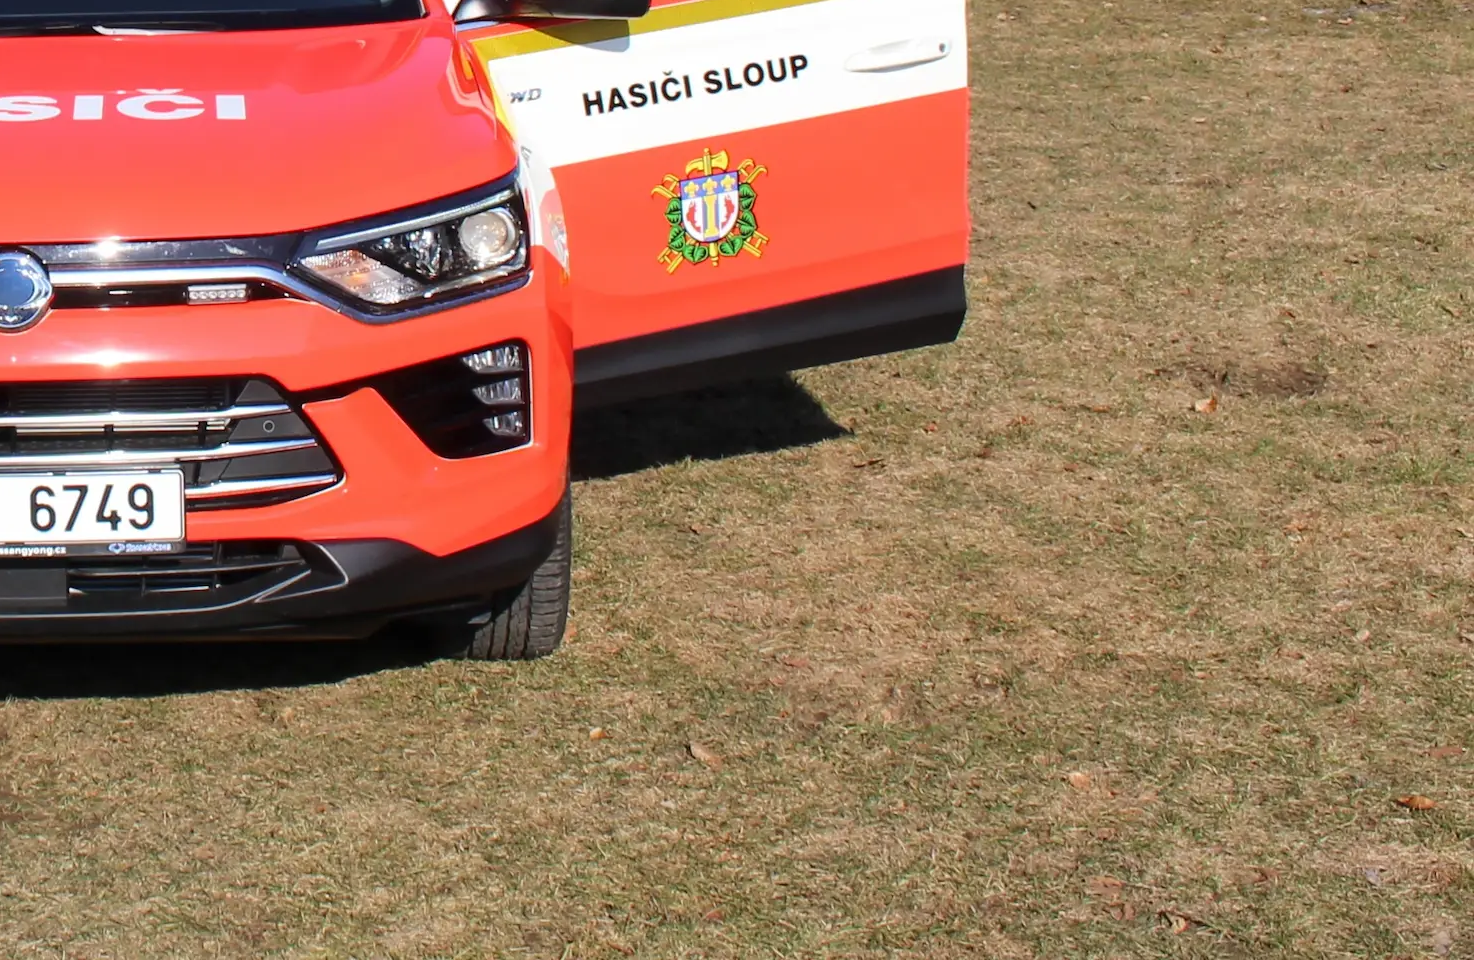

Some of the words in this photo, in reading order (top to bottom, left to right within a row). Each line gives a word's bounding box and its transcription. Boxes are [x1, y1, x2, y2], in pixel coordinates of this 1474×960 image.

[582, 69, 693, 116] HASIČI
[703, 54, 809, 94] SLOUP
[30, 483, 155, 533] 6749
